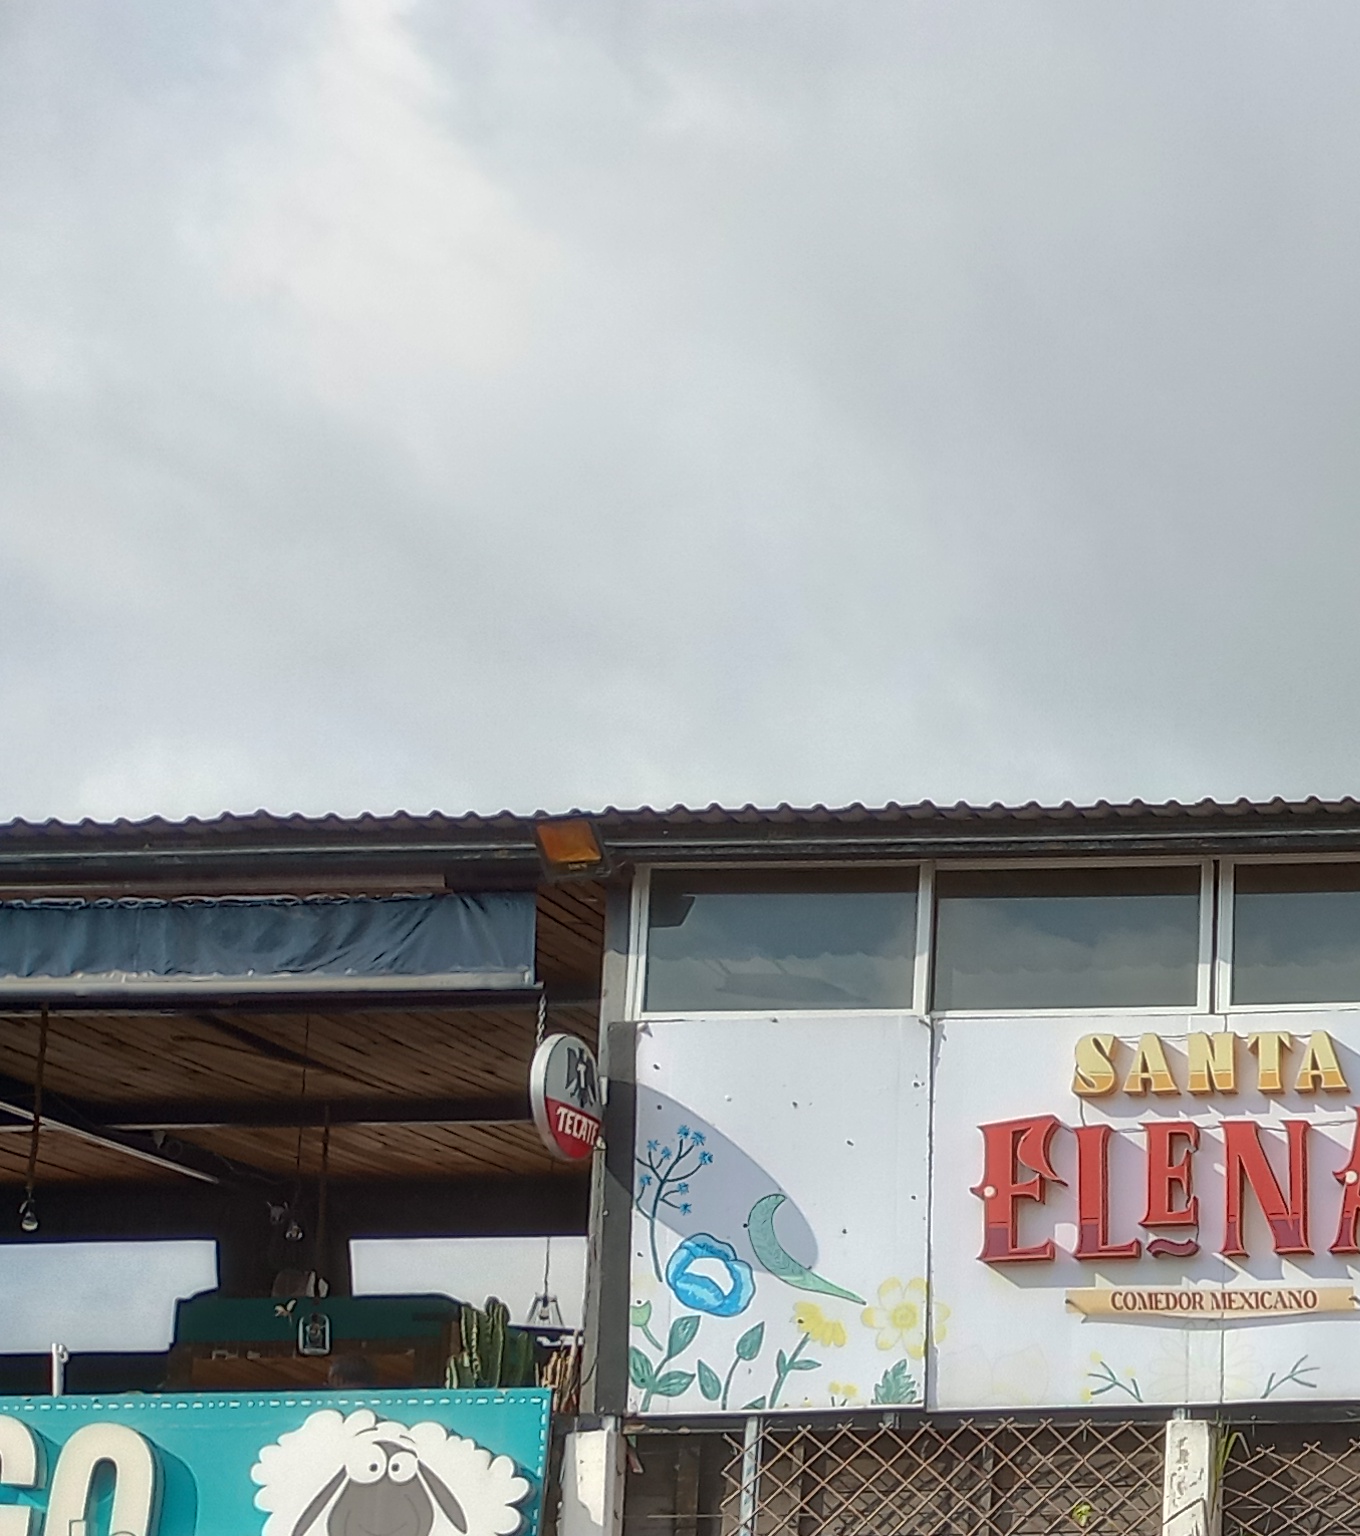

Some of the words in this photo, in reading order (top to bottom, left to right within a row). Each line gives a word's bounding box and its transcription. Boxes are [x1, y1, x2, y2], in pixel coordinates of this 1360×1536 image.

[1072, 1030, 1350, 1099] SANTA
[556, 1105, 600, 1147] TECATE
[1110, 1290, 1204, 1311] COMEDOR
[1210, 1289, 1318, 1311] MEXICANO
